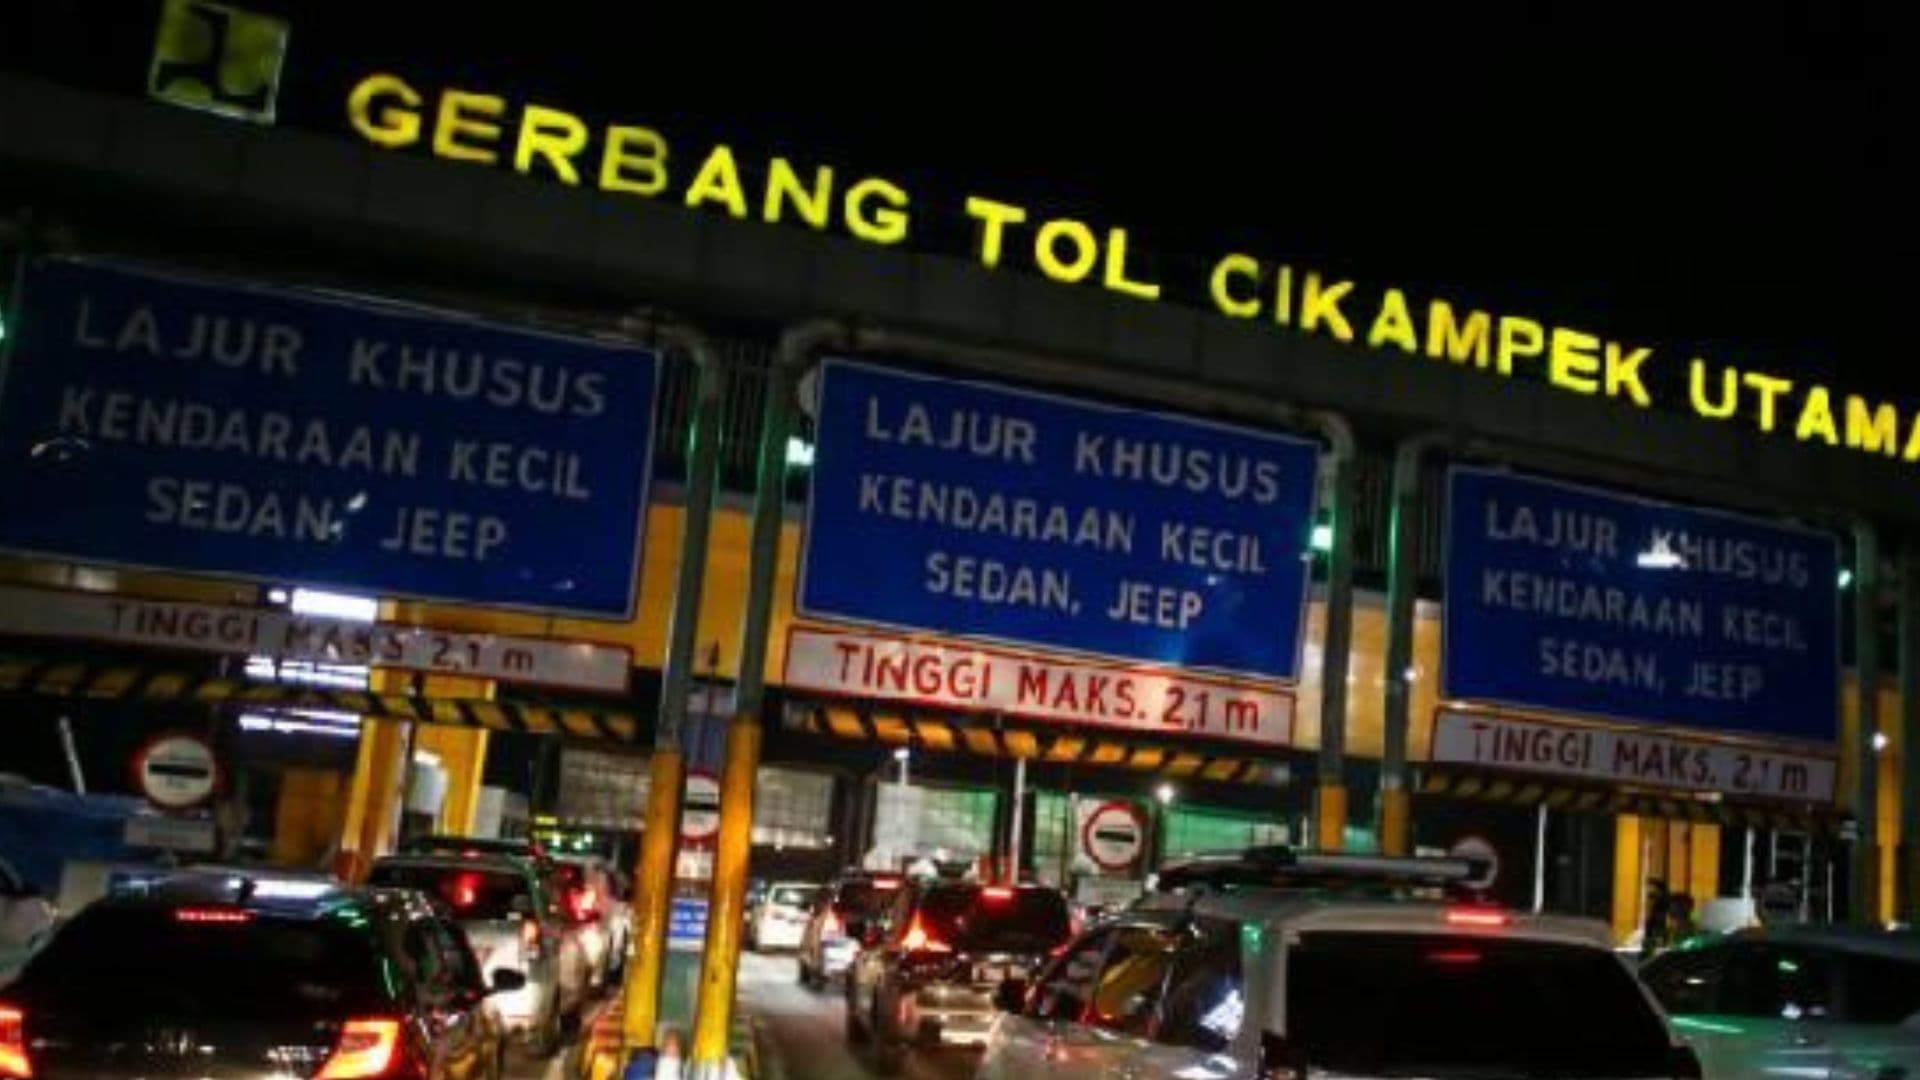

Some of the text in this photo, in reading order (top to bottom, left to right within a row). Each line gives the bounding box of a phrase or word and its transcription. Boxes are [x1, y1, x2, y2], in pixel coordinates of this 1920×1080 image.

[346, 72, 910, 244] GERBANG
[966, 196, 1160, 299] TOL
[1210, 253, 1653, 408] CIKAMPEK
[76, 300, 608, 416] LAJUR KHUSUS
[57, 383, 592, 500] KENDARAAN KECIL
[866, 396, 1281, 504] LAJUR KHUSUS
[380, 504, 508, 562] JEEP
[858, 474, 1267, 575] KENDARAAN KECIL
[1484, 499, 1810, 589] LAJUR KHUSUS
[926, 552, 1203, 631] SEDAN, JEEP
[1481, 568, 1808, 651] KENDARAAN KECIL
[108, 602, 259, 647] TINGGI
[503, 647, 536, 673] m
[1538, 636, 1766, 704] SEDAN, JEEP
[834, 641, 992, 700] TINGGI
[1016, 665, 1148, 721] MAKS.
[1223, 697, 1260, 733] m
[1470, 721, 1592, 770] TINGGI
[1612, 738, 1717, 786] MAKS.
[1780, 763, 1810, 794] m
